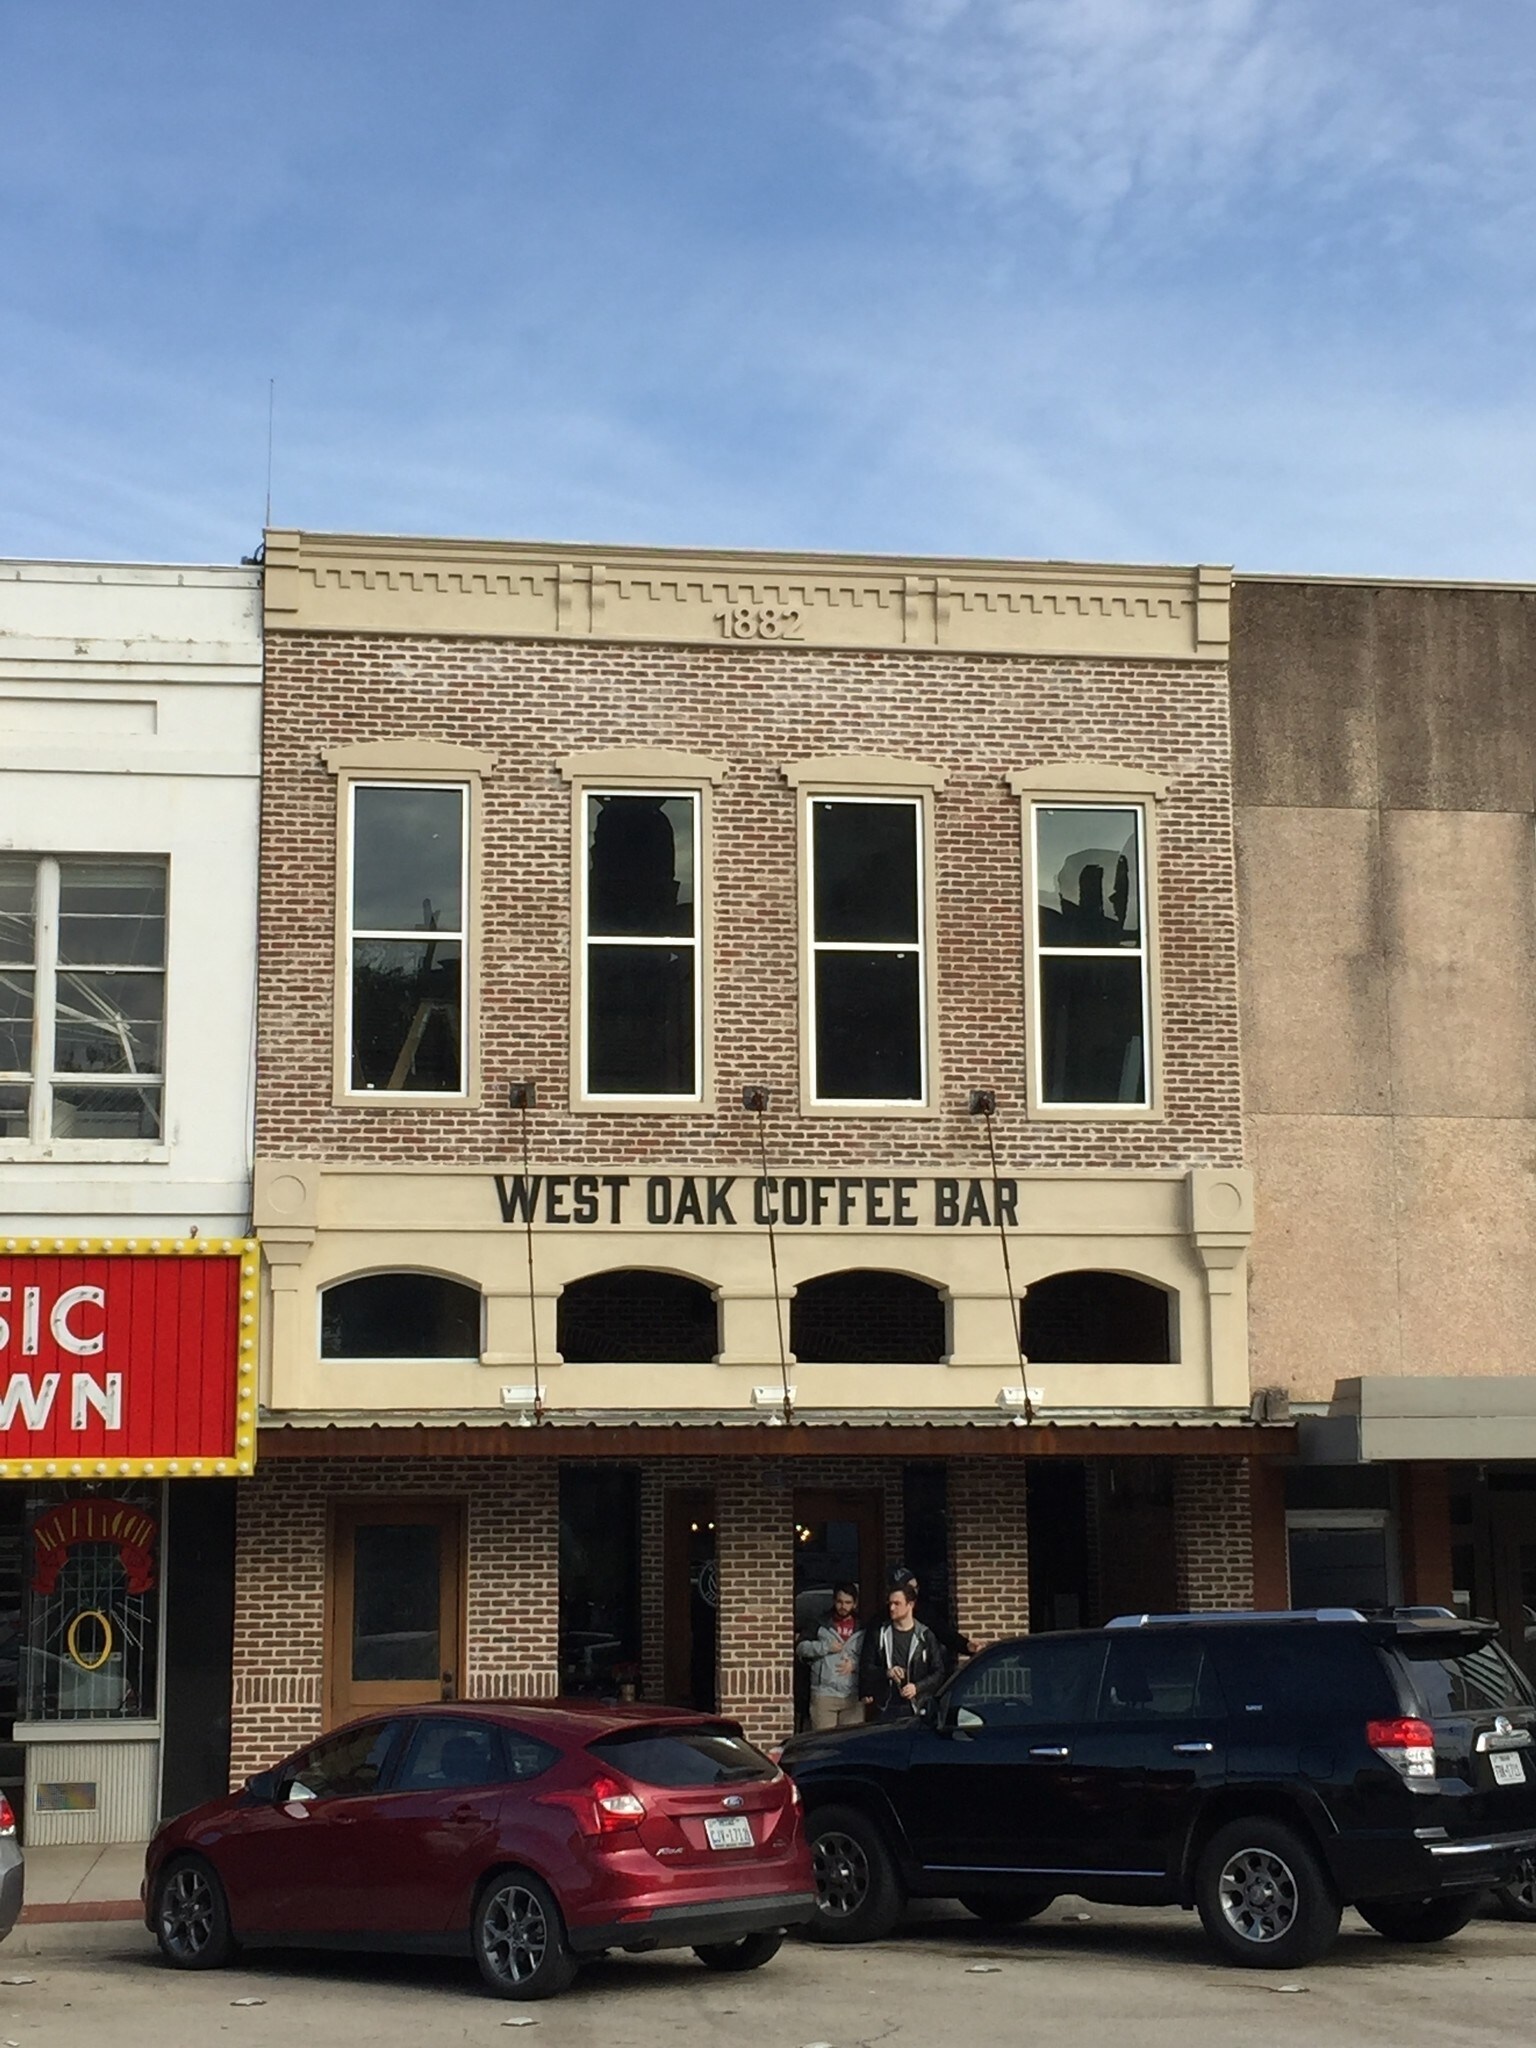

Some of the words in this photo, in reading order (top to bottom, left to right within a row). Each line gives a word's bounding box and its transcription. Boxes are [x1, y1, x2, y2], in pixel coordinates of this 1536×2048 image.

[713, 608, 805, 640] 1882
[494, 1175, 630, 1224] WEST
[647, 1176, 737, 1225] OAK
[754, 1177, 918, 1226] COFFEE
[935, 1178, 1019, 1226] BAR
[0, 1285, 104, 1355] IC
